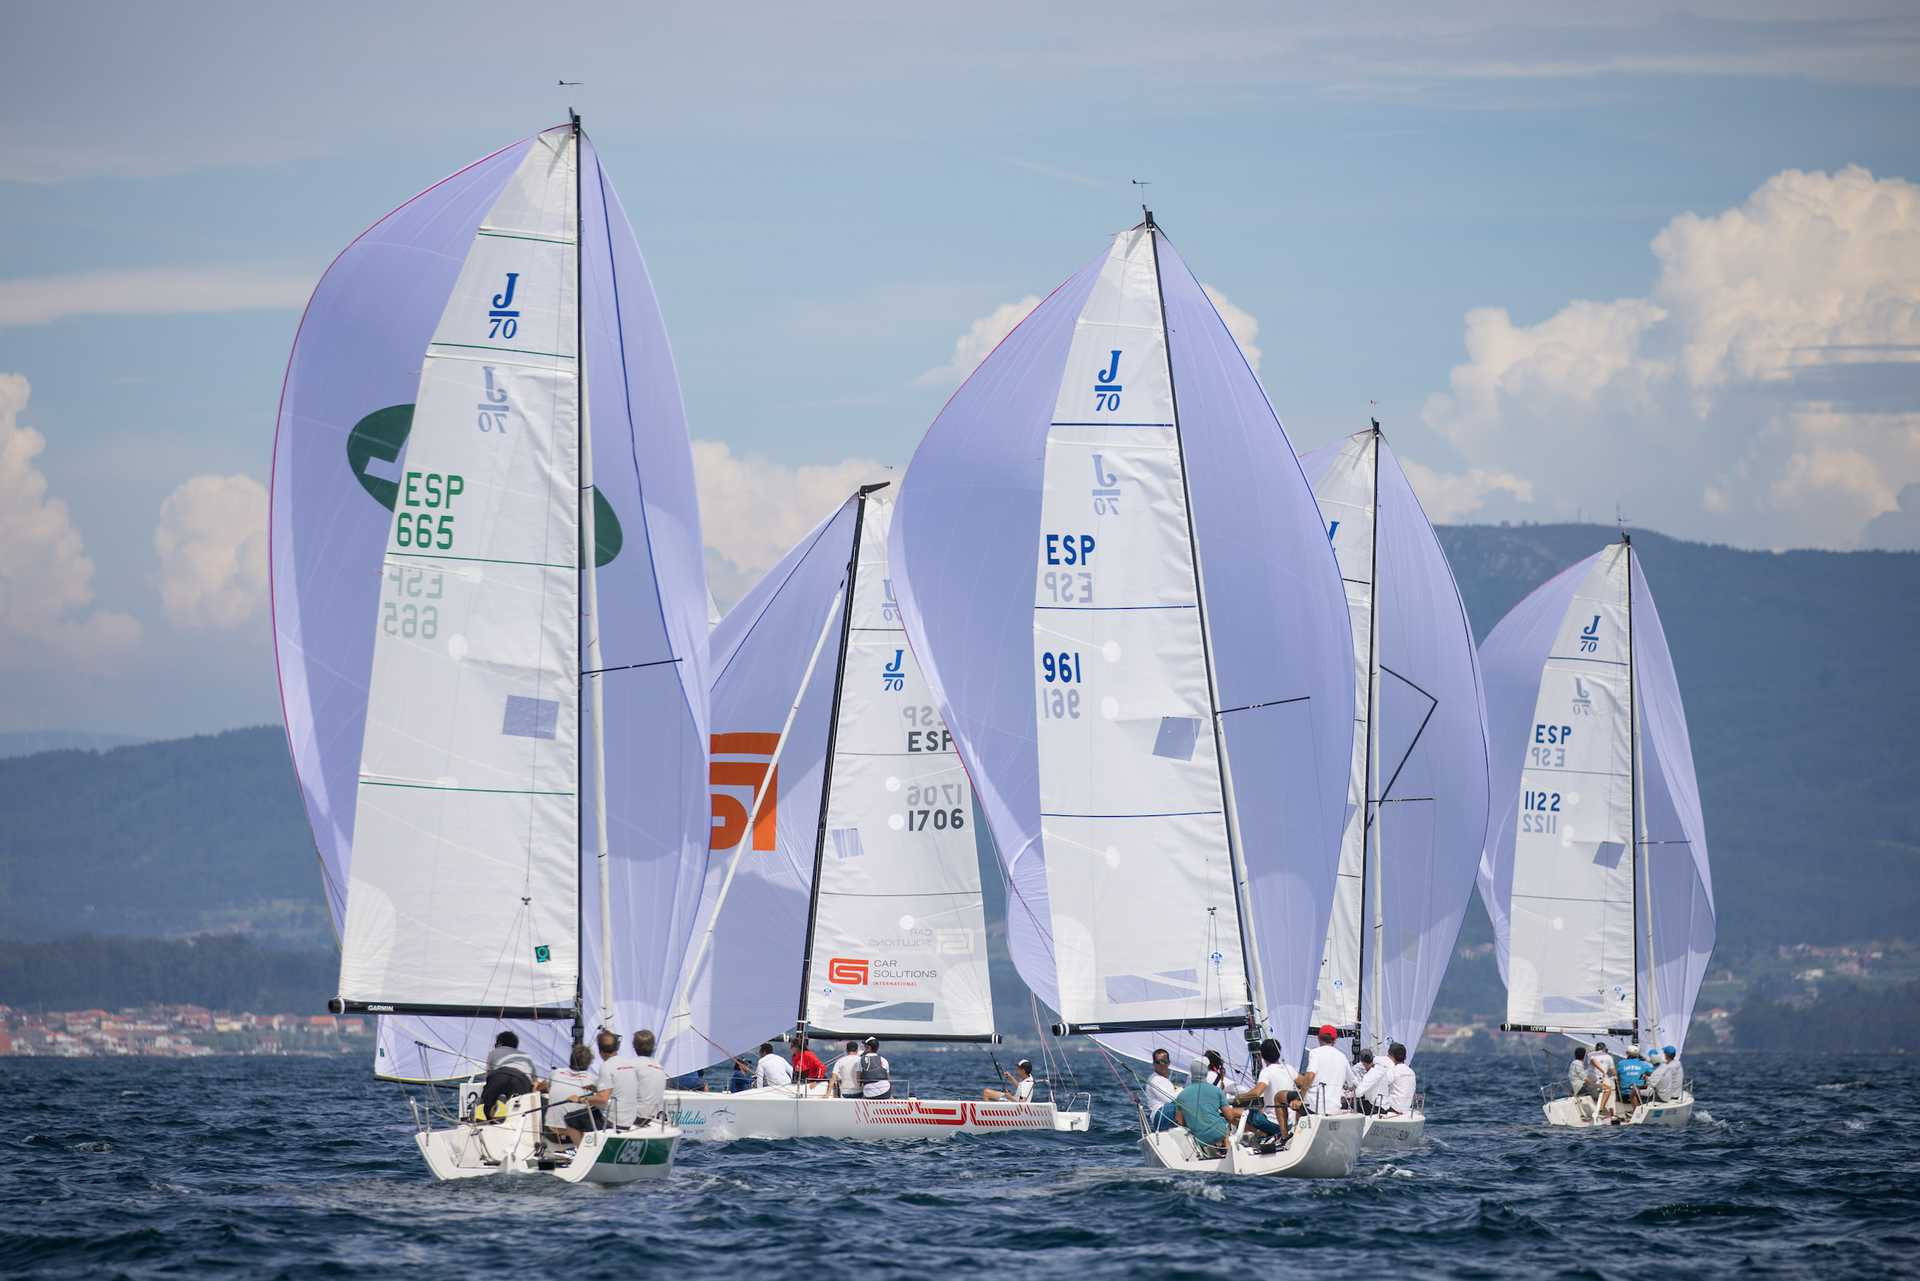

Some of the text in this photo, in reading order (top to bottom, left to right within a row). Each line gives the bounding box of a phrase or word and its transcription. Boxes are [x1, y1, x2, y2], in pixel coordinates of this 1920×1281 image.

[492, 272, 520, 310] J
[488, 318, 518, 340] 70
[1097, 350, 1123, 384] J
[1095, 393, 1121, 412] 70
[405, 471, 465, 509] ESP
[396, 513, 455, 550] 665
[1046, 534, 1096, 566] ESP
[1583, 615, 1602, 635] J
[1580, 641, 1598, 653] 70
[885, 649, 904, 672] J
[1042, 652, 1082, 684] 961
[883, 678, 904, 692] 70
[908, 730, 952, 752] ESP
[1535, 724, 1572, 745] ESP
[1525, 790, 1561, 812] 1122
[908, 808, 964, 832] 1706
[873, 959, 898, 968] CAR
[873, 970, 937, 978] SOLUTIONS
